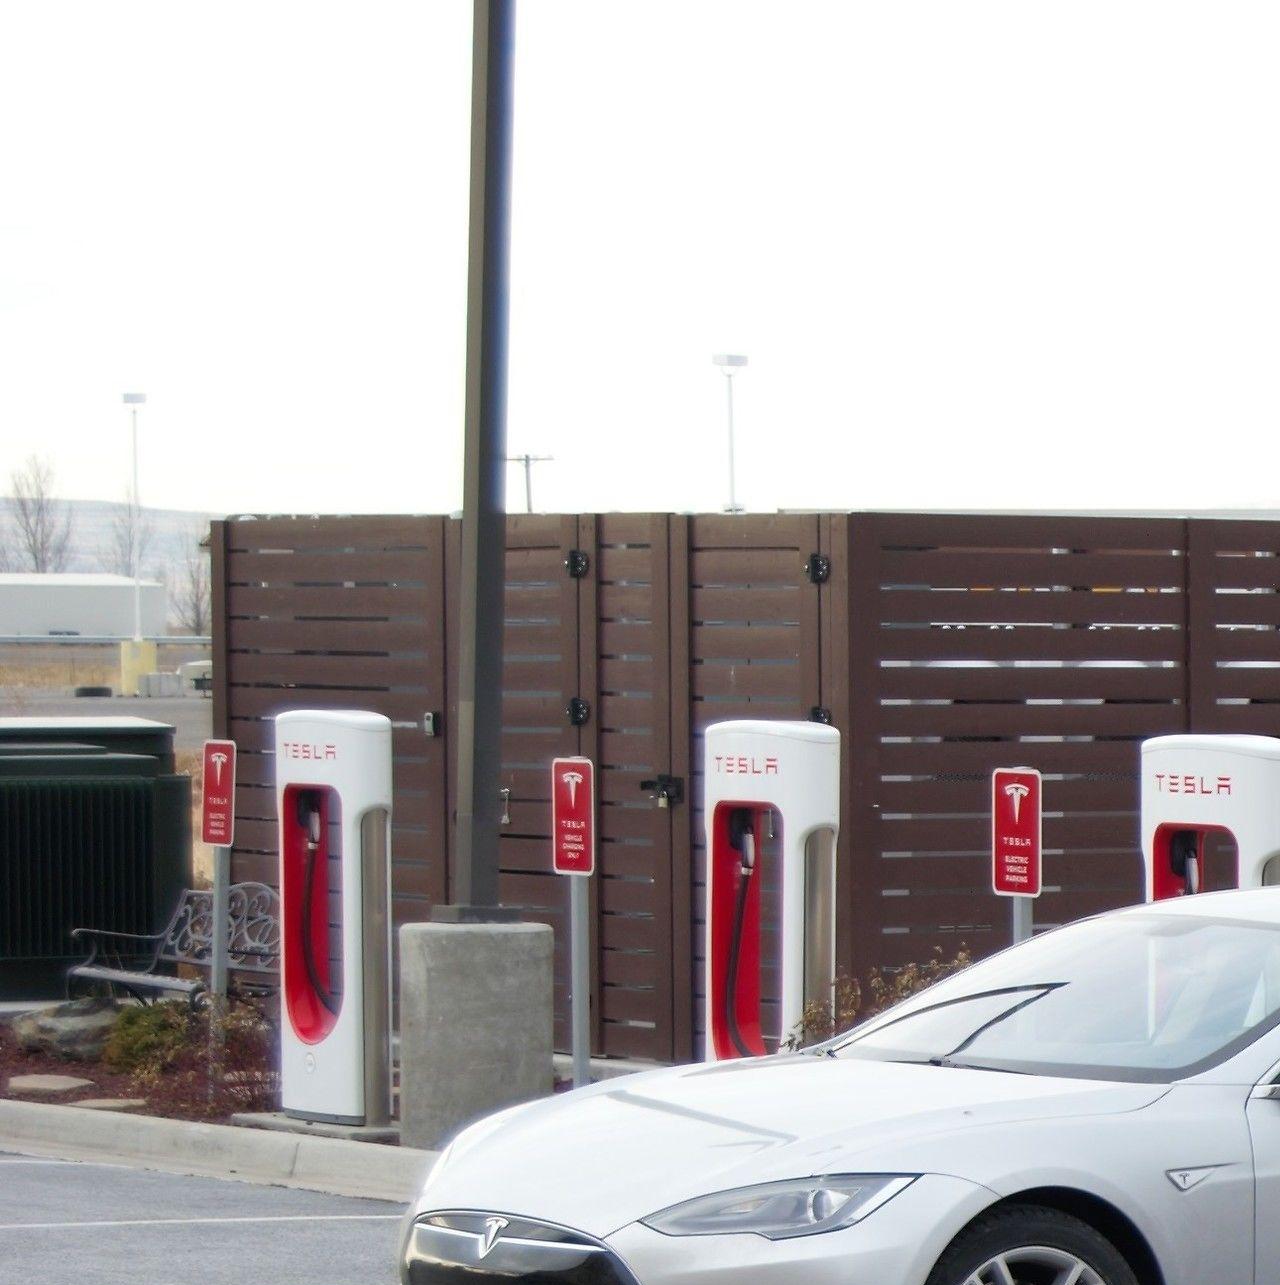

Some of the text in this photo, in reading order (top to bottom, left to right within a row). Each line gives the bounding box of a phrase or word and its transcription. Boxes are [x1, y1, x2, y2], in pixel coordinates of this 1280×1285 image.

[284, 743, 336, 759] TESLA
[715, 756, 778, 774] TESLA
[1156, 775, 1231, 795] TESLA
[562, 820, 586, 828] TESLA
[1003, 837, 1031, 846] TESLA
